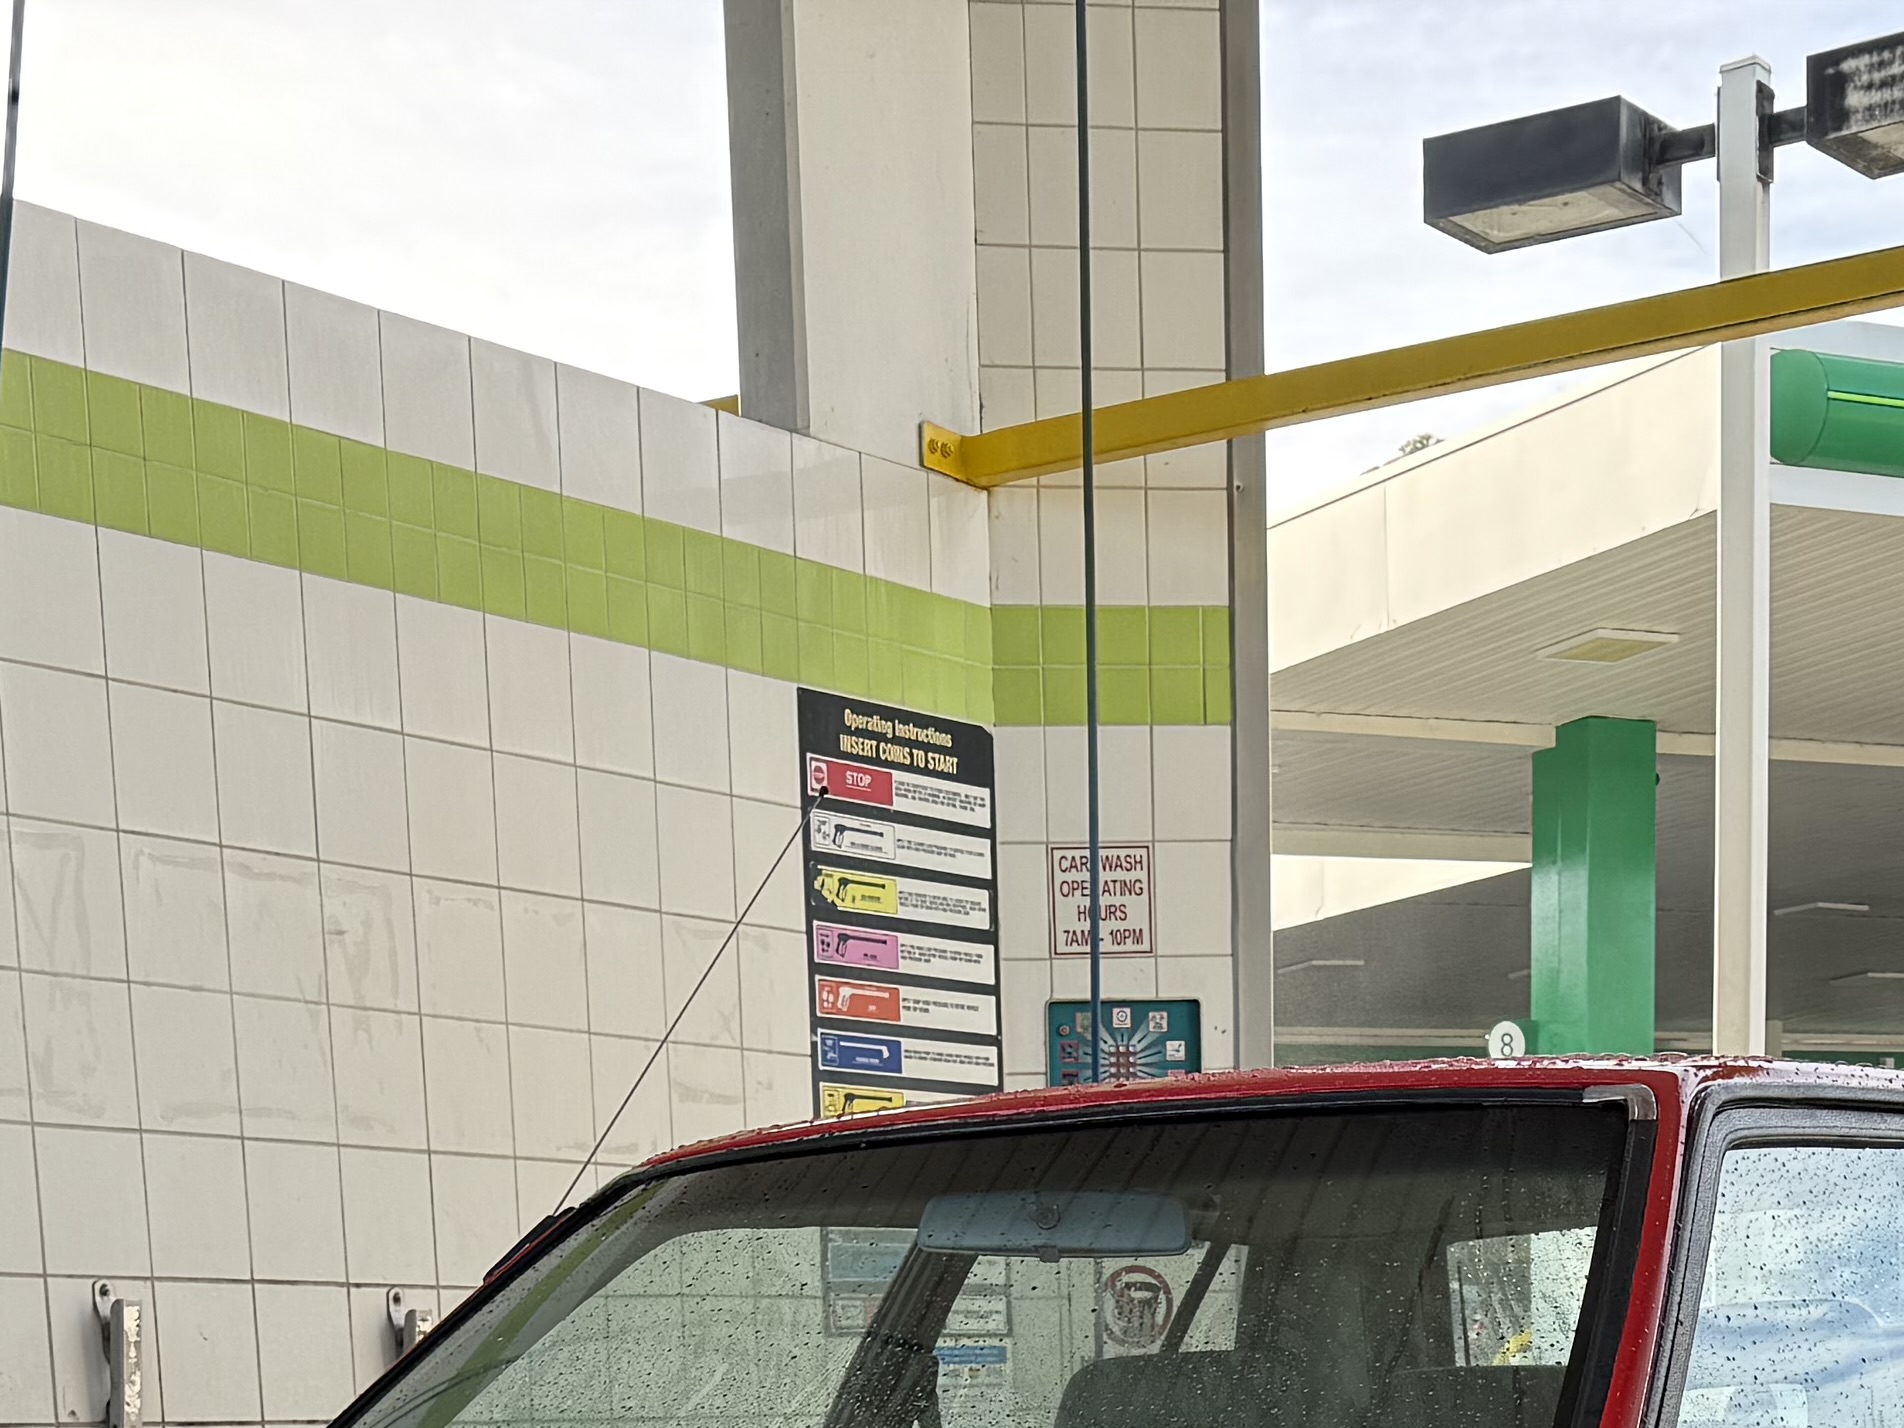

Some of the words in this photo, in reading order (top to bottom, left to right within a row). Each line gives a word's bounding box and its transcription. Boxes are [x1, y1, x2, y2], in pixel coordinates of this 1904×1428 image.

[844, 708, 893, 738] Operating
[895, 719, 953, 748] Instructions
[839, 734, 877, 758] INSERT
[880, 742, 911, 765] COINS
[912, 749, 925, 769] TO
[927, 752, 958, 774] START
[845, 770, 872, 787] STOP
[1059, 855, 1090, 873] CAR
[1100, 854, 1143, 872] WASH
[1060, 879, 1143, 898] OPEATING
[1063, 930, 1091, 947] 7AM
[1109, 928, 1143, 946] 10PM
